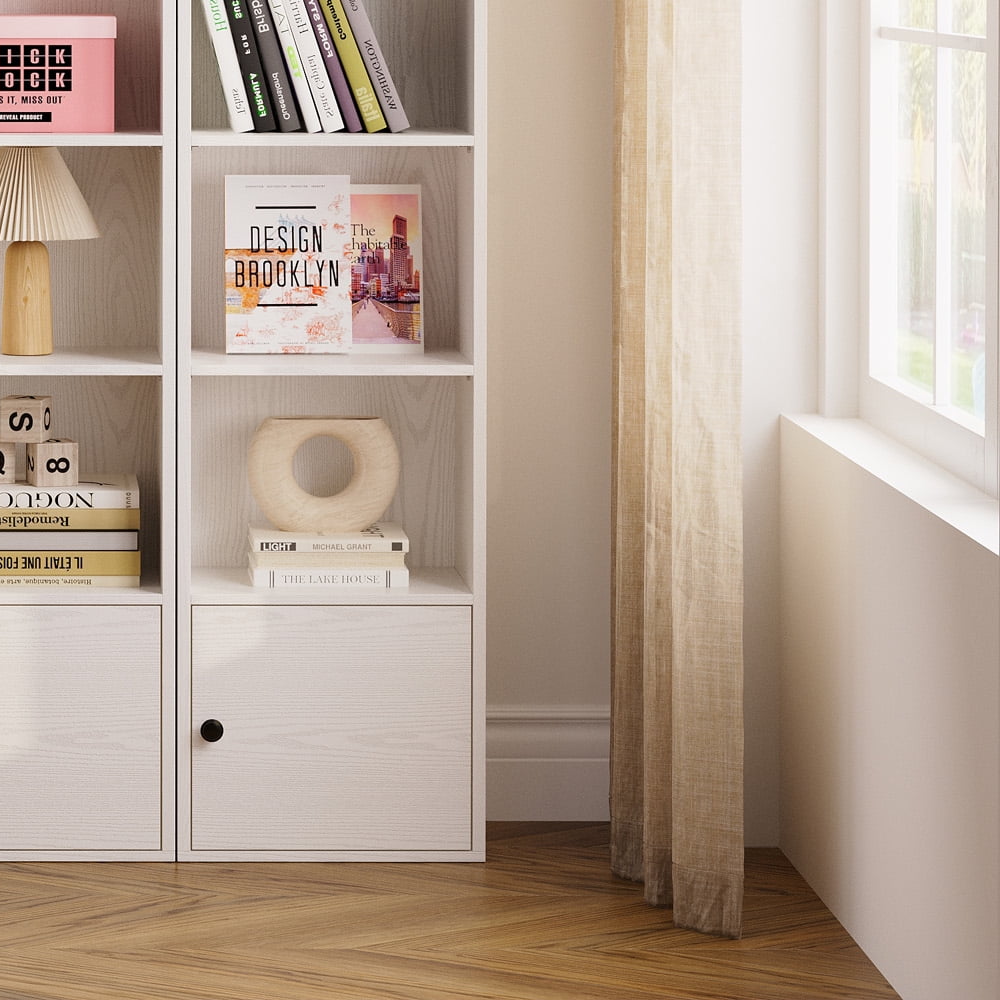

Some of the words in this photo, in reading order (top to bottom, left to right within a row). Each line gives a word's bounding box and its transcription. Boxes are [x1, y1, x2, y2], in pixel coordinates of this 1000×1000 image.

[7, 96, 18, 105] IT,
[21, 96, 43, 104] MISS
[46, 96, 62, 104] OUT
[350, 224, 376, 236] The
[250, 226, 323, 253] DESIGN
[350, 252, 380, 264] arth
[235, 260, 340, 288] BROOKLYN
[8, 412, 34, 432] S
[46, 457, 70, 474] 8
[263, 542, 292, 551] LIGHT
[22, 556, 41, 568] UNE
[44, 556, 72, 571] ÉTAIT
[73, 556, 83, 568] IL
[282, 574, 306, 584] THE
[310, 574, 338, 584] LAKE
[342, 574, 380, 584] HOUSE
